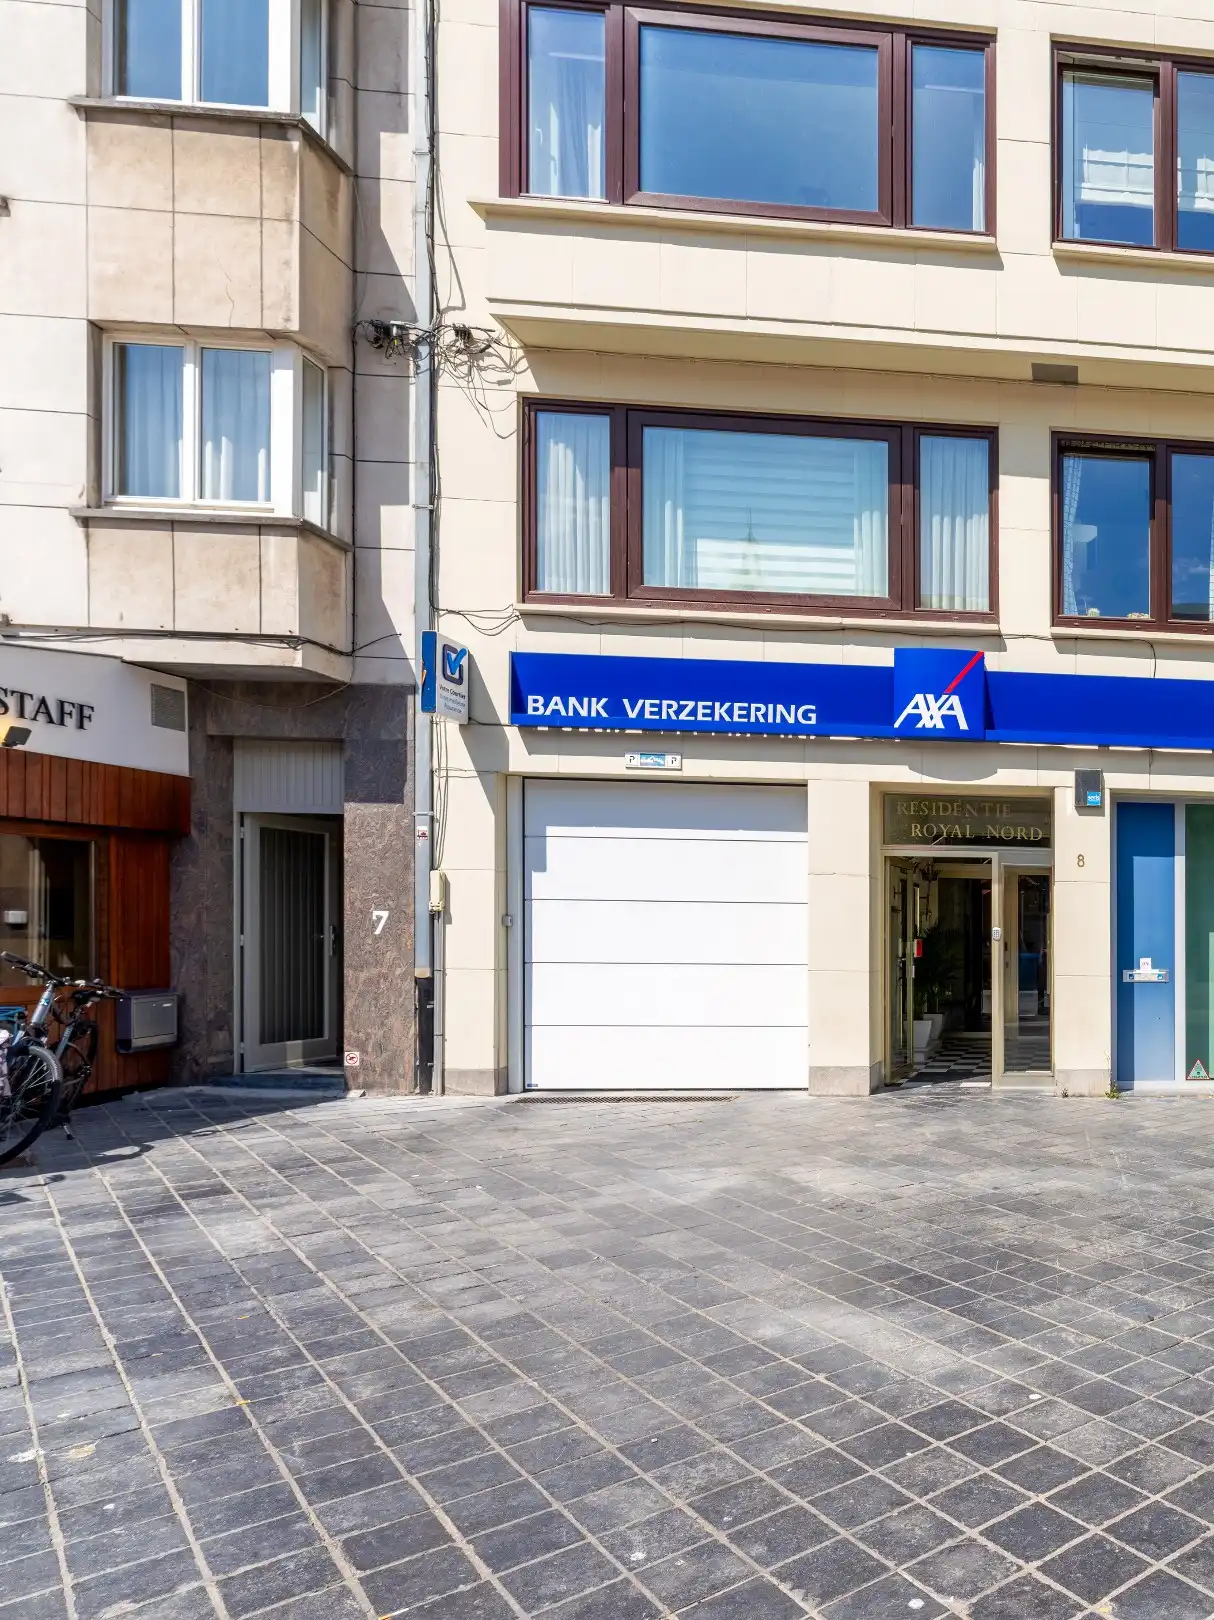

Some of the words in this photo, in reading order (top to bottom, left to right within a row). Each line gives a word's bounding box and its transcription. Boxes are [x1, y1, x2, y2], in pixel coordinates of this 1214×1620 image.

[527, 695, 609, 718] BANK
[622, 698, 817, 725] VERZEKERING
[894, 693, 969, 730] AXA
[896, 800, 1012, 818] RESIDENTIE
[910, 823, 975, 839] ROYAL
[986, 824, 1043, 841] NORD
[1076, 854, 1086, 868] 8
[372, 910, 389, 935] 7
